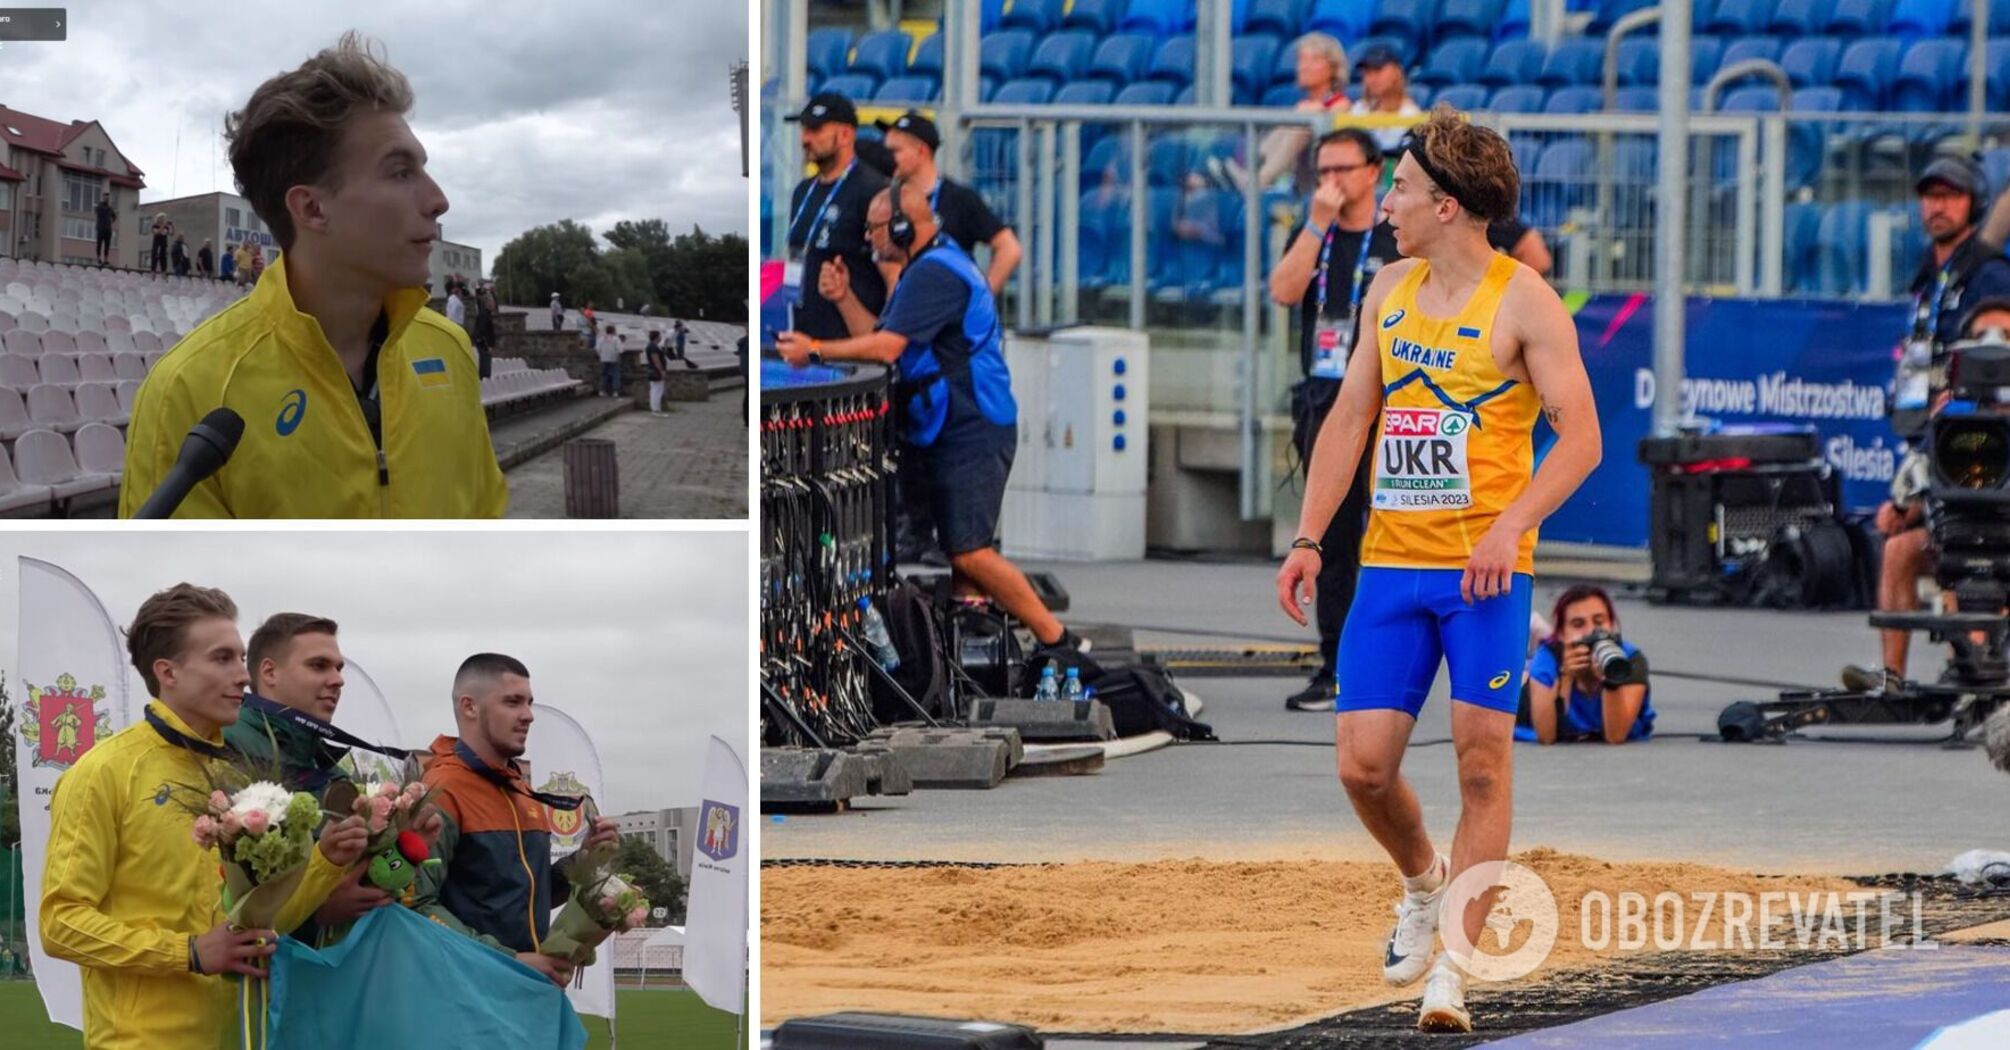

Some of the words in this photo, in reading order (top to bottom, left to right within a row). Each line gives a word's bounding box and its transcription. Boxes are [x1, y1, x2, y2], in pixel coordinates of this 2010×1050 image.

[1391, 337, 1456, 369] UKRAINE
[1758, 370, 1885, 420] Mistrzostwa
[1386, 413, 1438, 433] SPAR
[1384, 439, 1460, 476] UKR
[1826, 435, 1894, 482] Silesia
[1395, 479, 1412, 489] RUN
[1400, 494, 1440, 505] SILESIA
[1441, 494, 1469, 505] 2023
